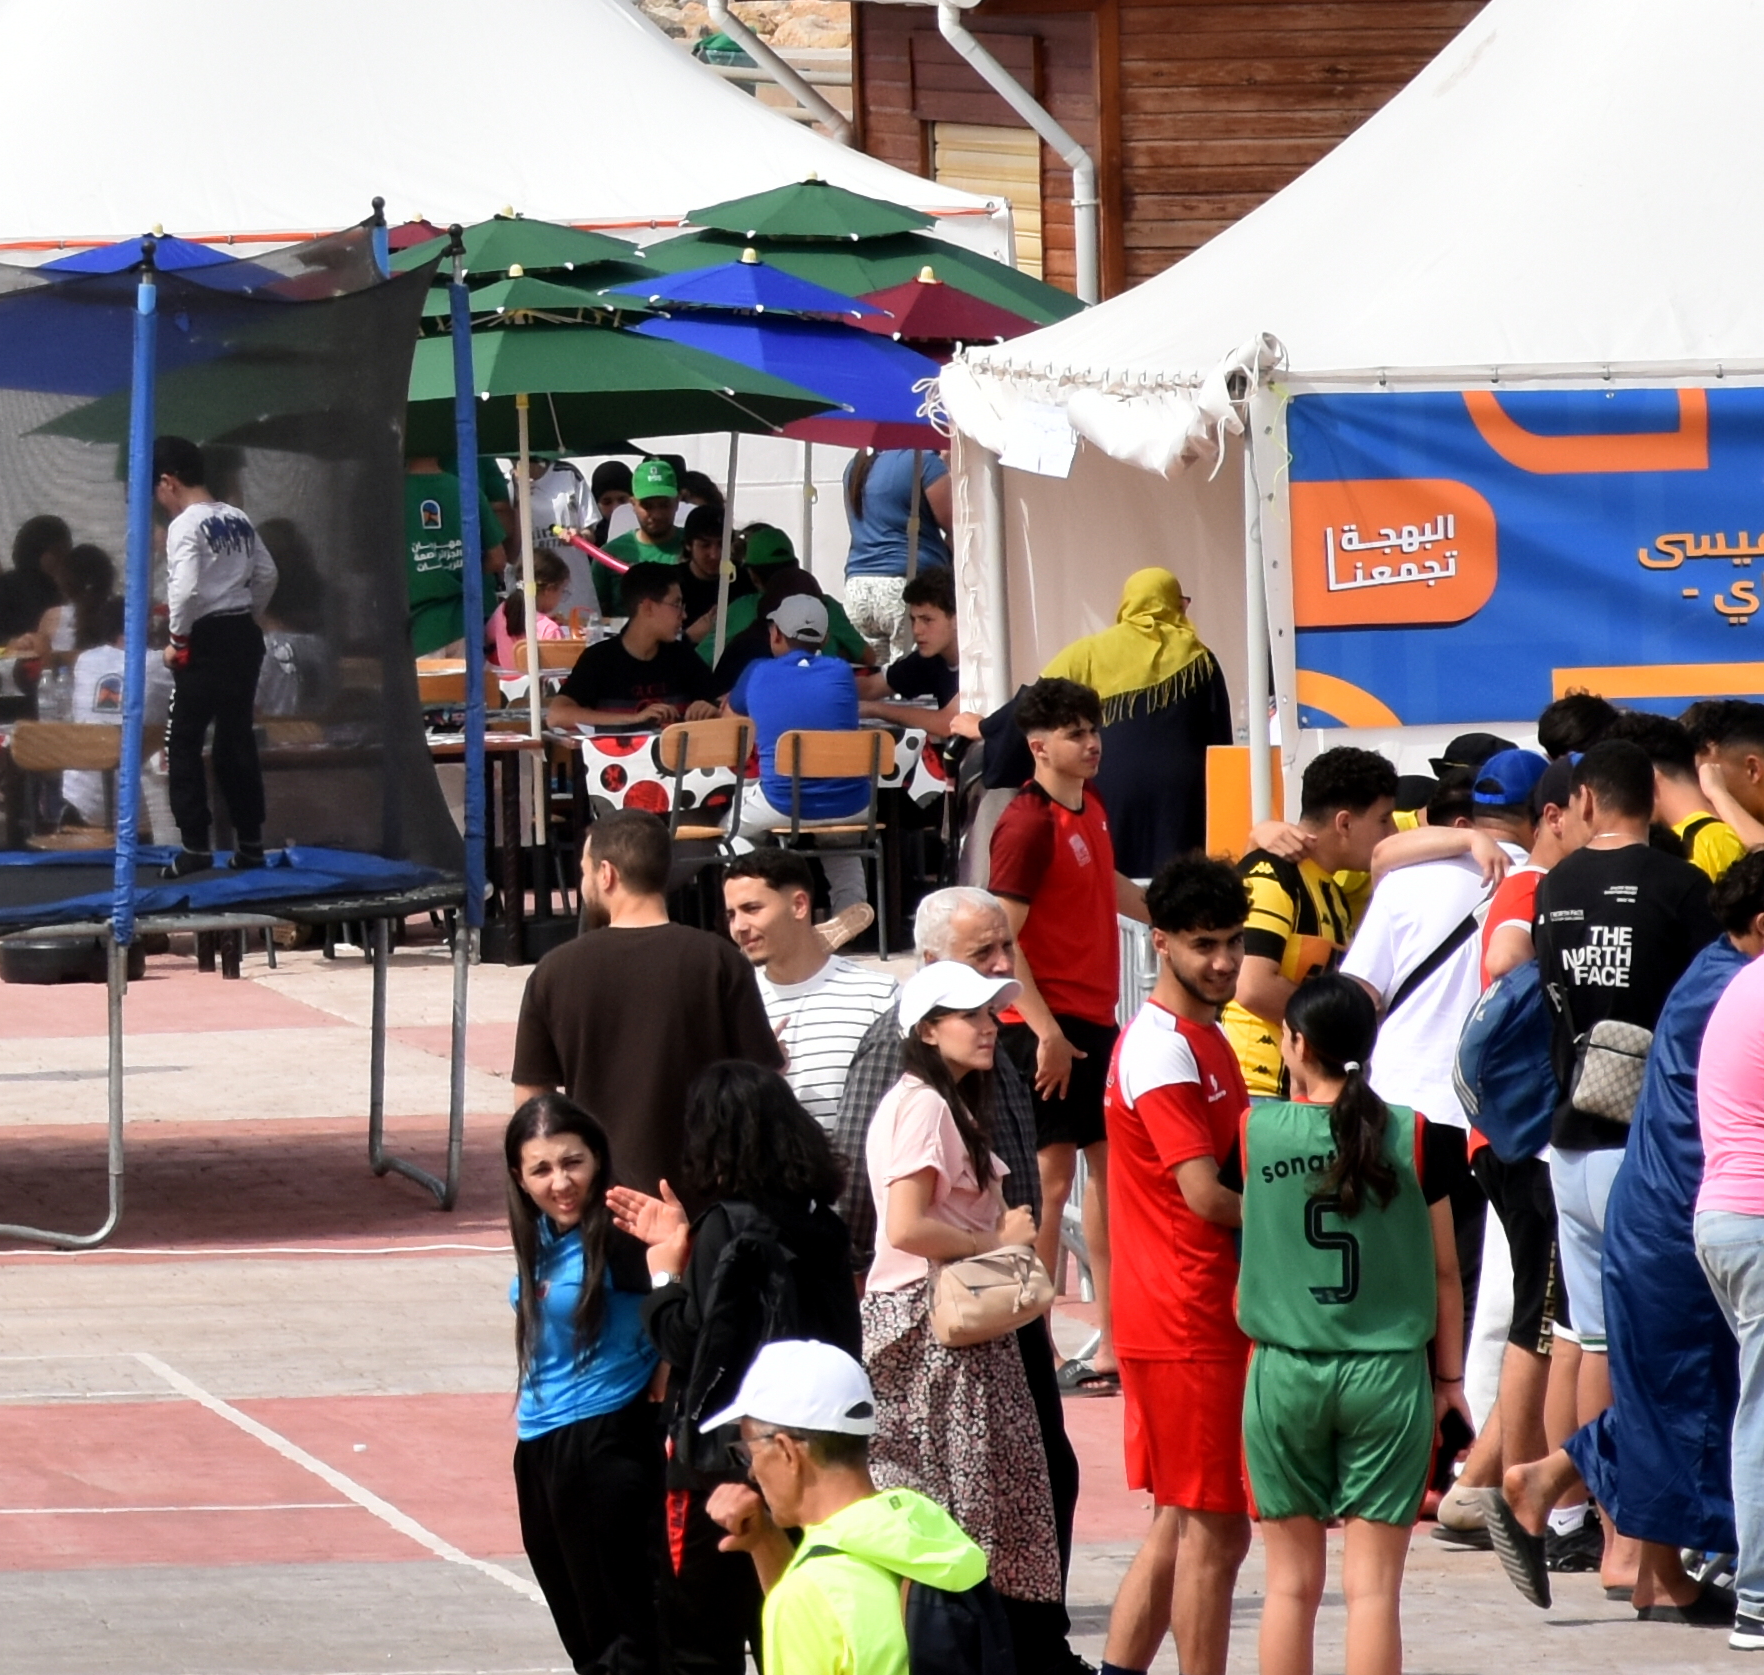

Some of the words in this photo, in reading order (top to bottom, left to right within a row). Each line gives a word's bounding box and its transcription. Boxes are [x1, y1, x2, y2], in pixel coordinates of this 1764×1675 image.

[1341, 513, 1455, 554] البهجة
[1325, 526, 1458, 592] تجمعنا
[1590, 926, 1633, 946] THE
[1574, 966, 1630, 988] FACE
[1304, 1194, 1360, 1305] 5
